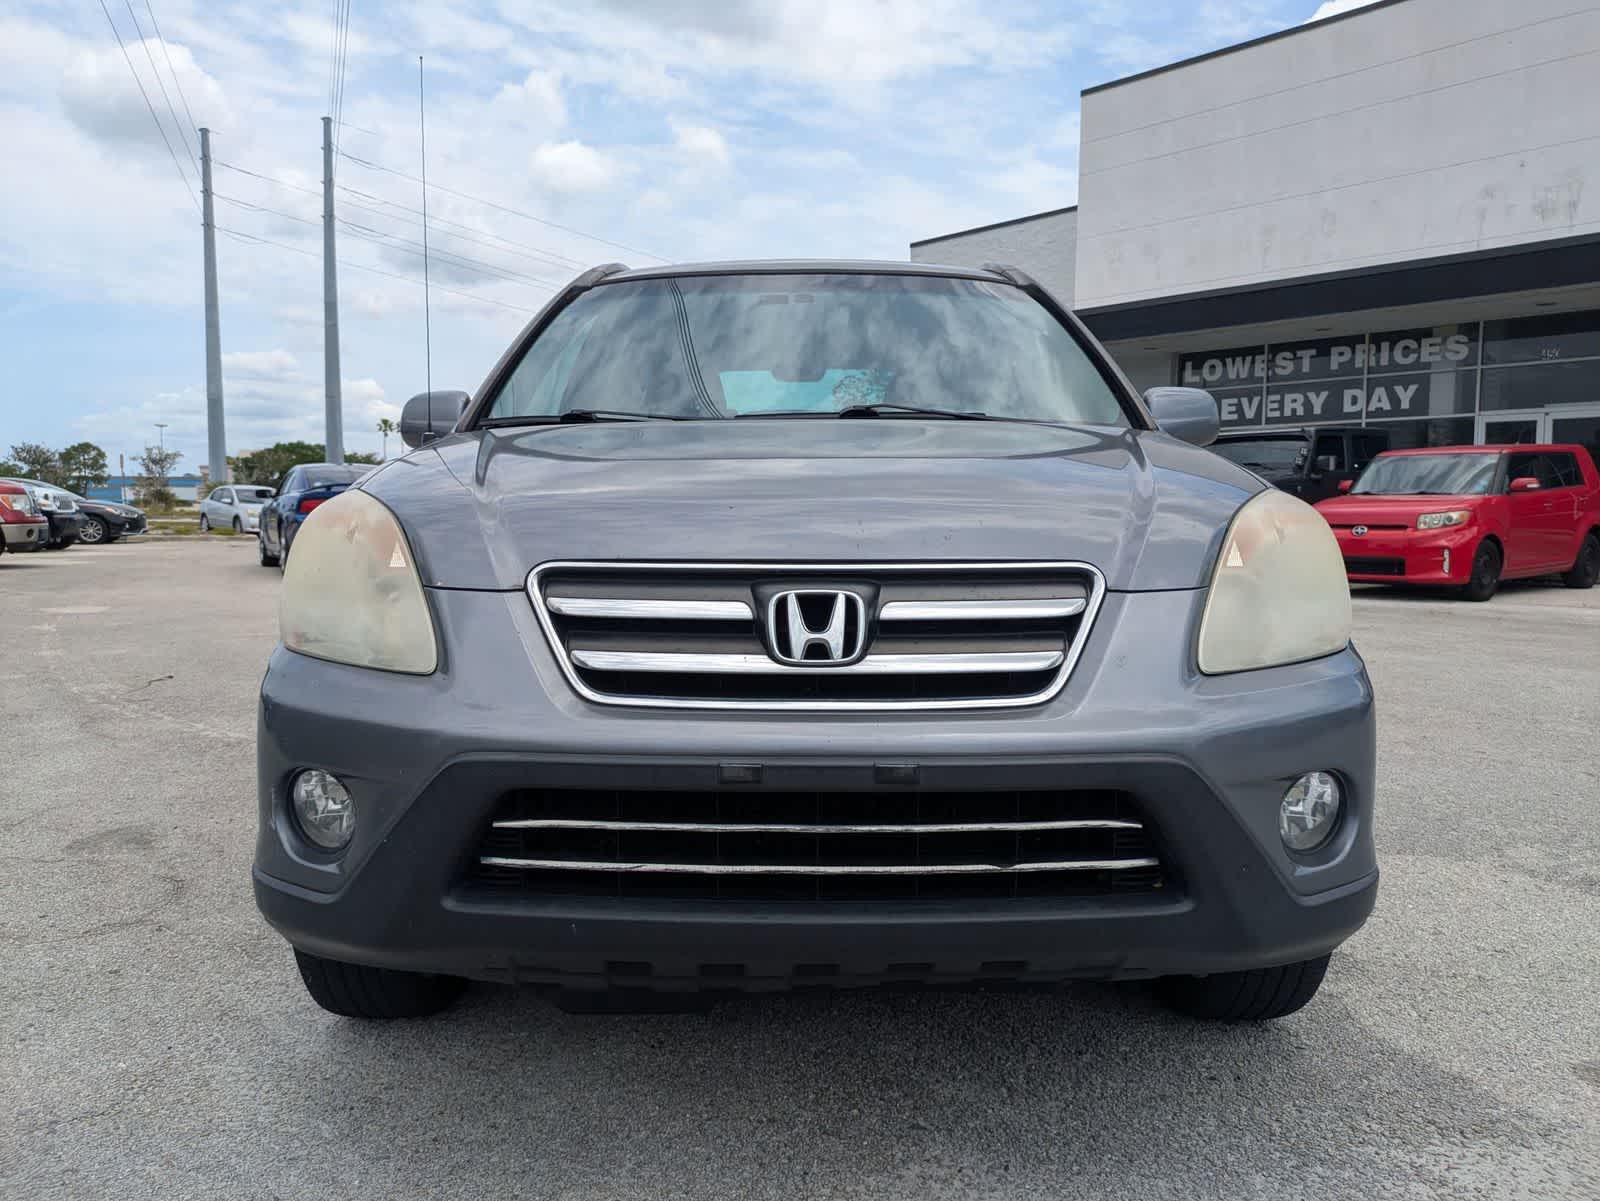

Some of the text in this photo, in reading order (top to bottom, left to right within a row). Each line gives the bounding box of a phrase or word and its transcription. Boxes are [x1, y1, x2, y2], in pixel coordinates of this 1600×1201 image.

[1184, 334, 1469, 384] LOWEST PRICES
[1220, 384, 1419, 420] EVERY DAY
